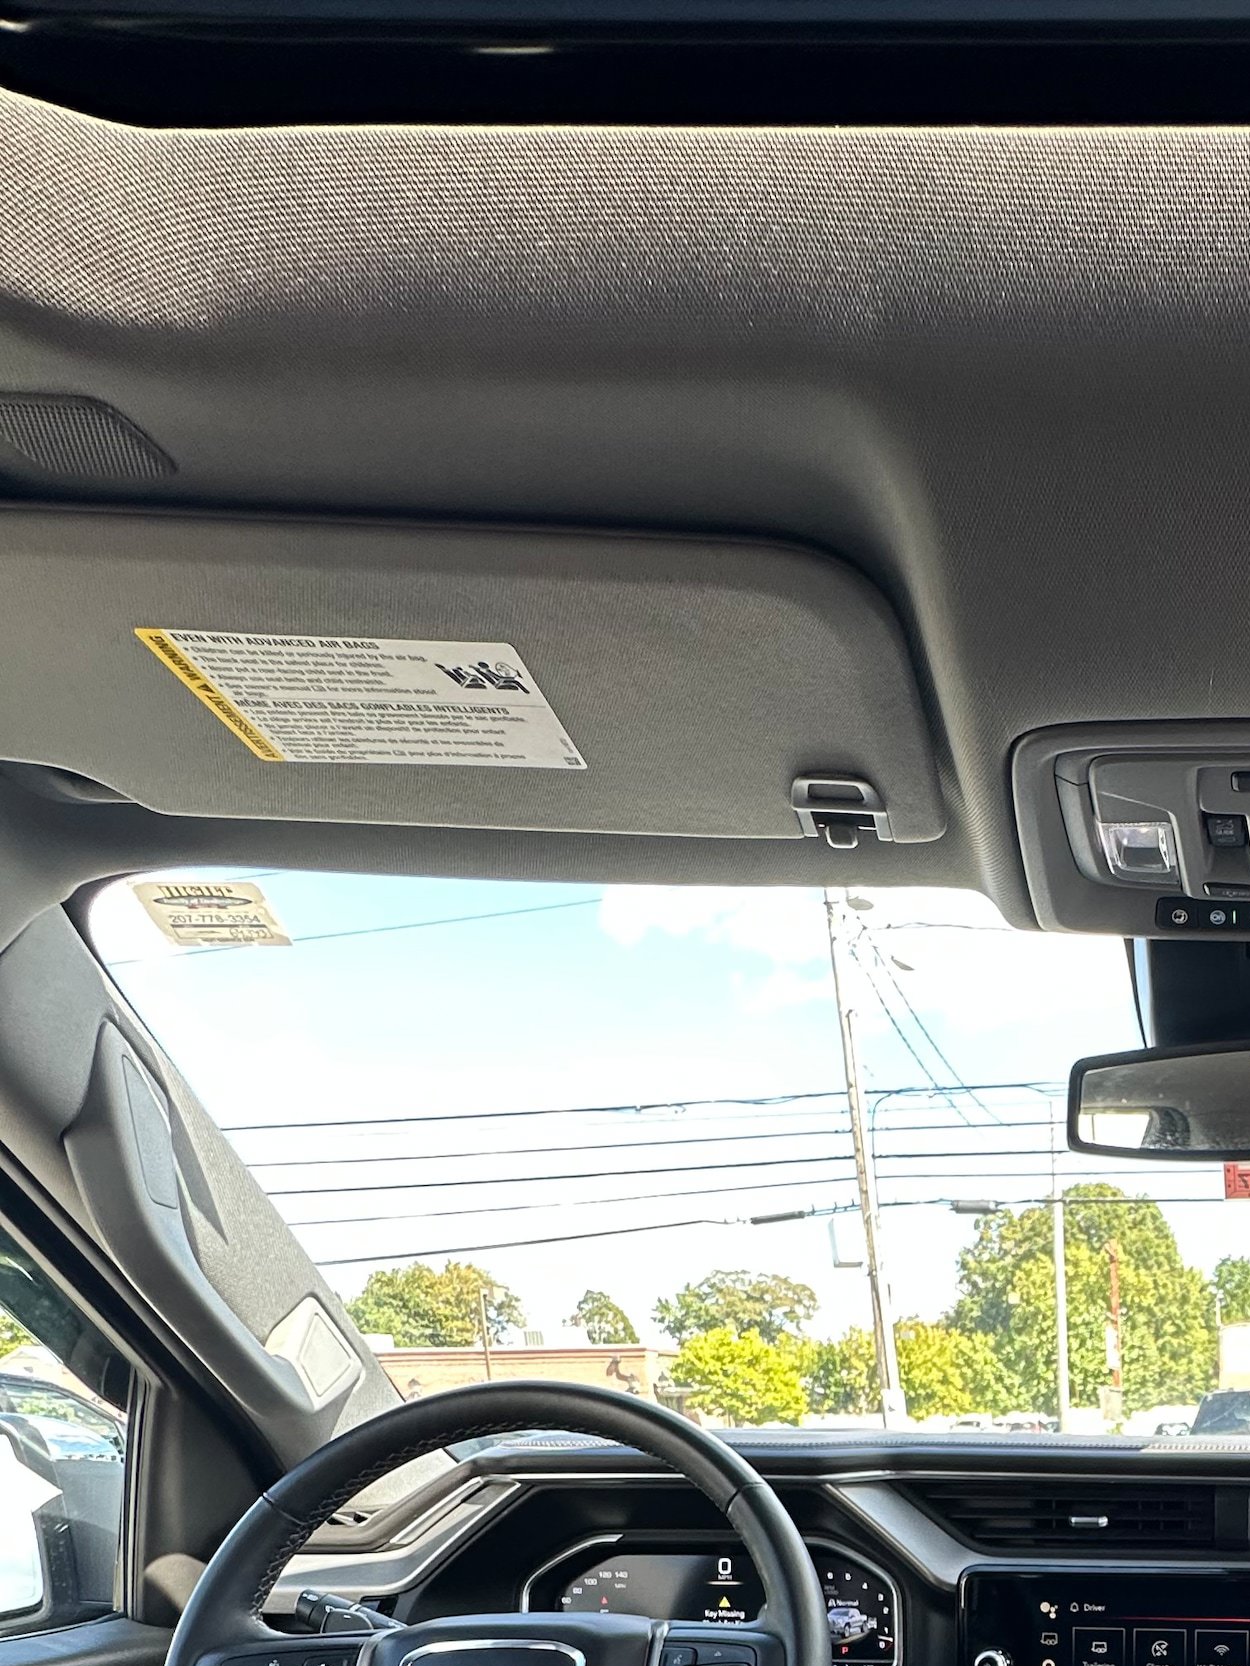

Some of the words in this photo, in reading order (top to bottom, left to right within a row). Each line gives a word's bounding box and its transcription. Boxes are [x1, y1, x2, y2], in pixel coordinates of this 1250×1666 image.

[170, 633, 207, 643] EVEN
[207, 635, 244, 644] WITH
[245, 637, 316, 647] ADVANCED
[319, 640, 342, 649] AIR
[342, 640, 379, 650] BAGS
[149, 636, 200, 681] WARNING
[272, 701, 302, 709] AVEC
[303, 702, 328, 710] DES
[327, 702, 360, 711] SACS
[360, 702, 433, 713] GONFLABLES
[433, 704, 510, 715] INTELLIGENTS
[718, 1557, 732, 1575] 0
[584, 1578, 598, 1586] 100
[1083, 1604, 1106, 1612] Driver
[704, 1609, 718, 1619] Key
[718, 1609, 745, 1620] Missing
[842, 1646, 849, 1654] P
